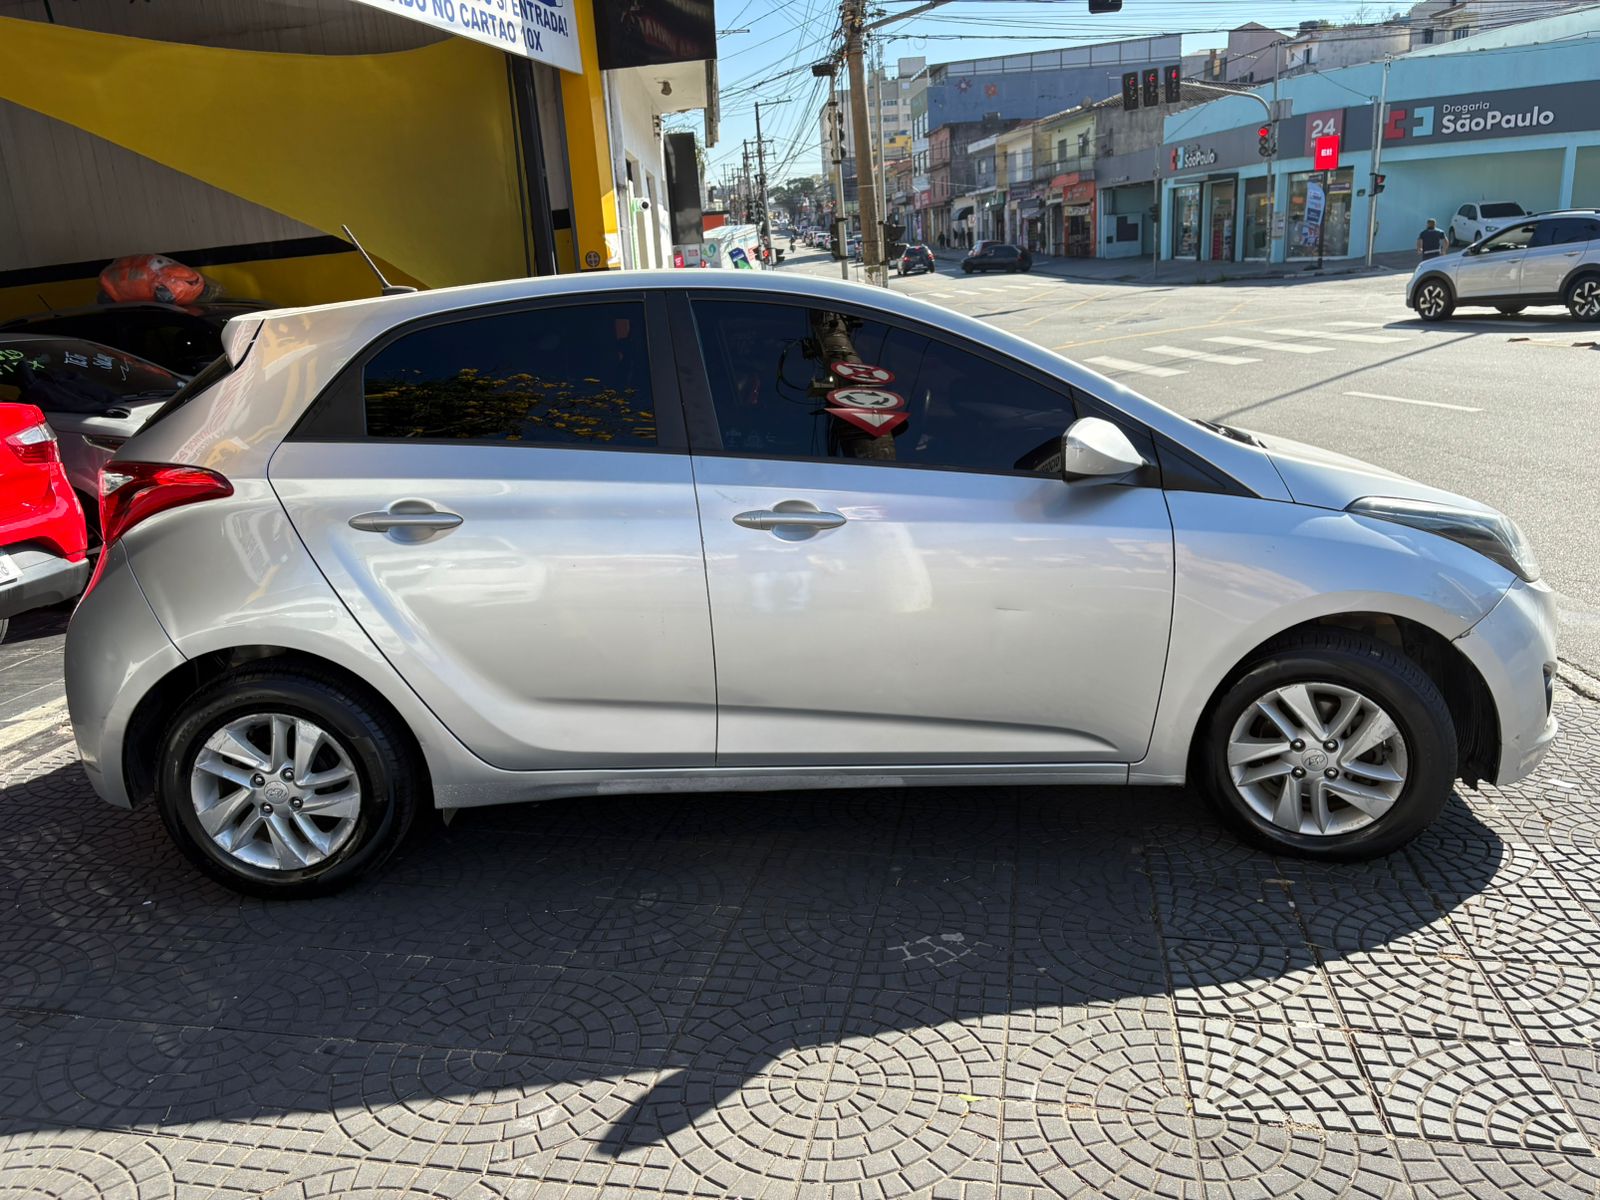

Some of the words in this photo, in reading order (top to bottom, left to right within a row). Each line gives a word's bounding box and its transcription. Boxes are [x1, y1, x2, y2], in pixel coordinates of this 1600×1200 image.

[459, 2, 517, 43] CARTAO
[521, 25, 544, 52] 10X
[511, 0, 569, 37] ENTRADA!
[1441, 105, 1555, 134] SãoPaulo
[1443, 101, 1490, 114] Drogaria
[1311, 118, 1336, 139] 24
